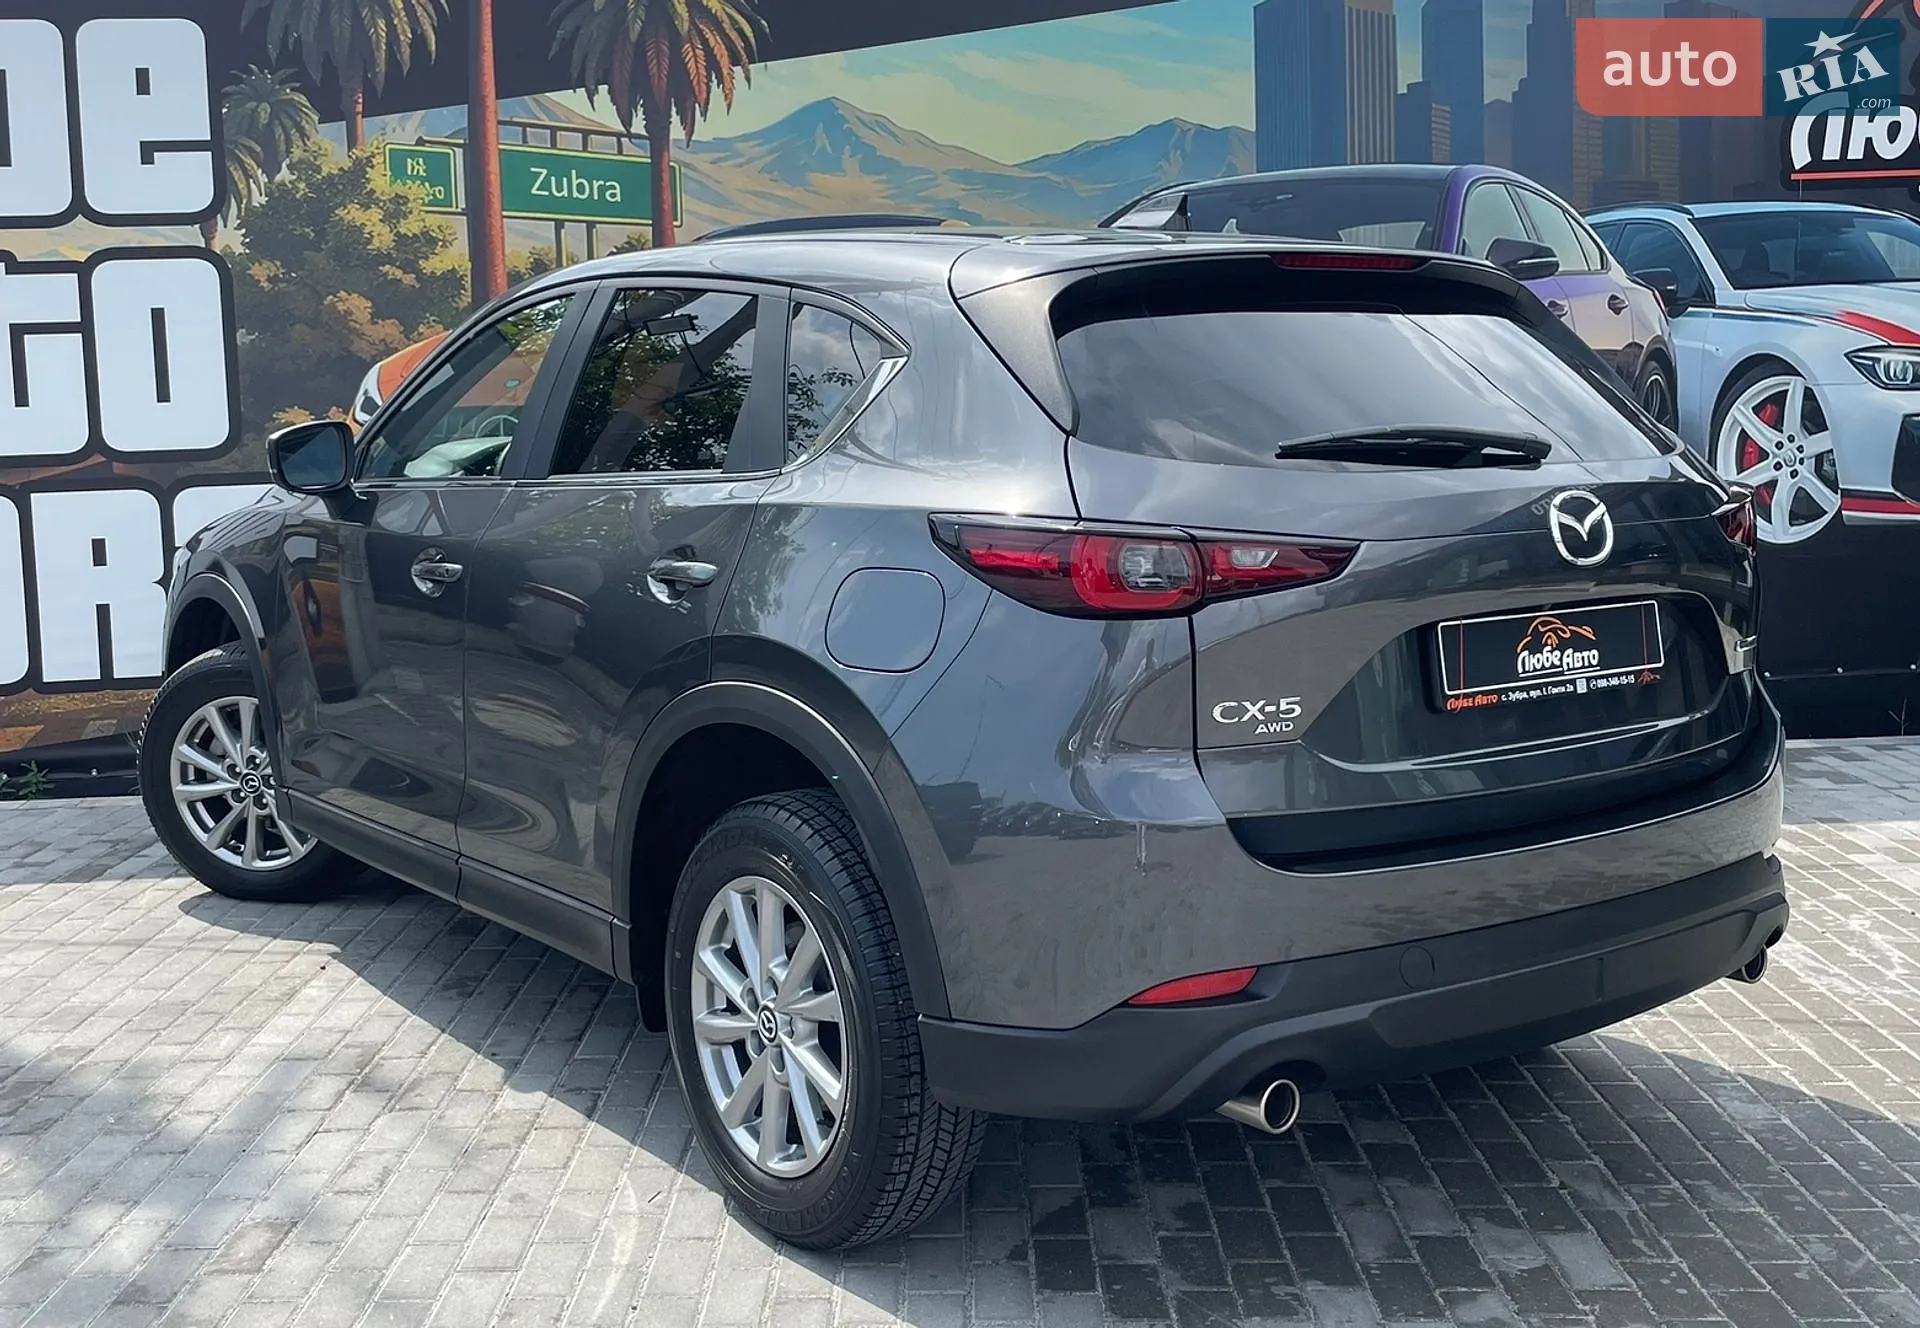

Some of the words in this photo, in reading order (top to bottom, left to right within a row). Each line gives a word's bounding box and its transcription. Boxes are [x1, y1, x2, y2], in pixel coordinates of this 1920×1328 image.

[1790, 91, 1920, 170] Лю
[529, 167, 622, 203] Zubra
[1211, 696, 1302, 724] CX-5
[1254, 721, 1294, 735] AWD
